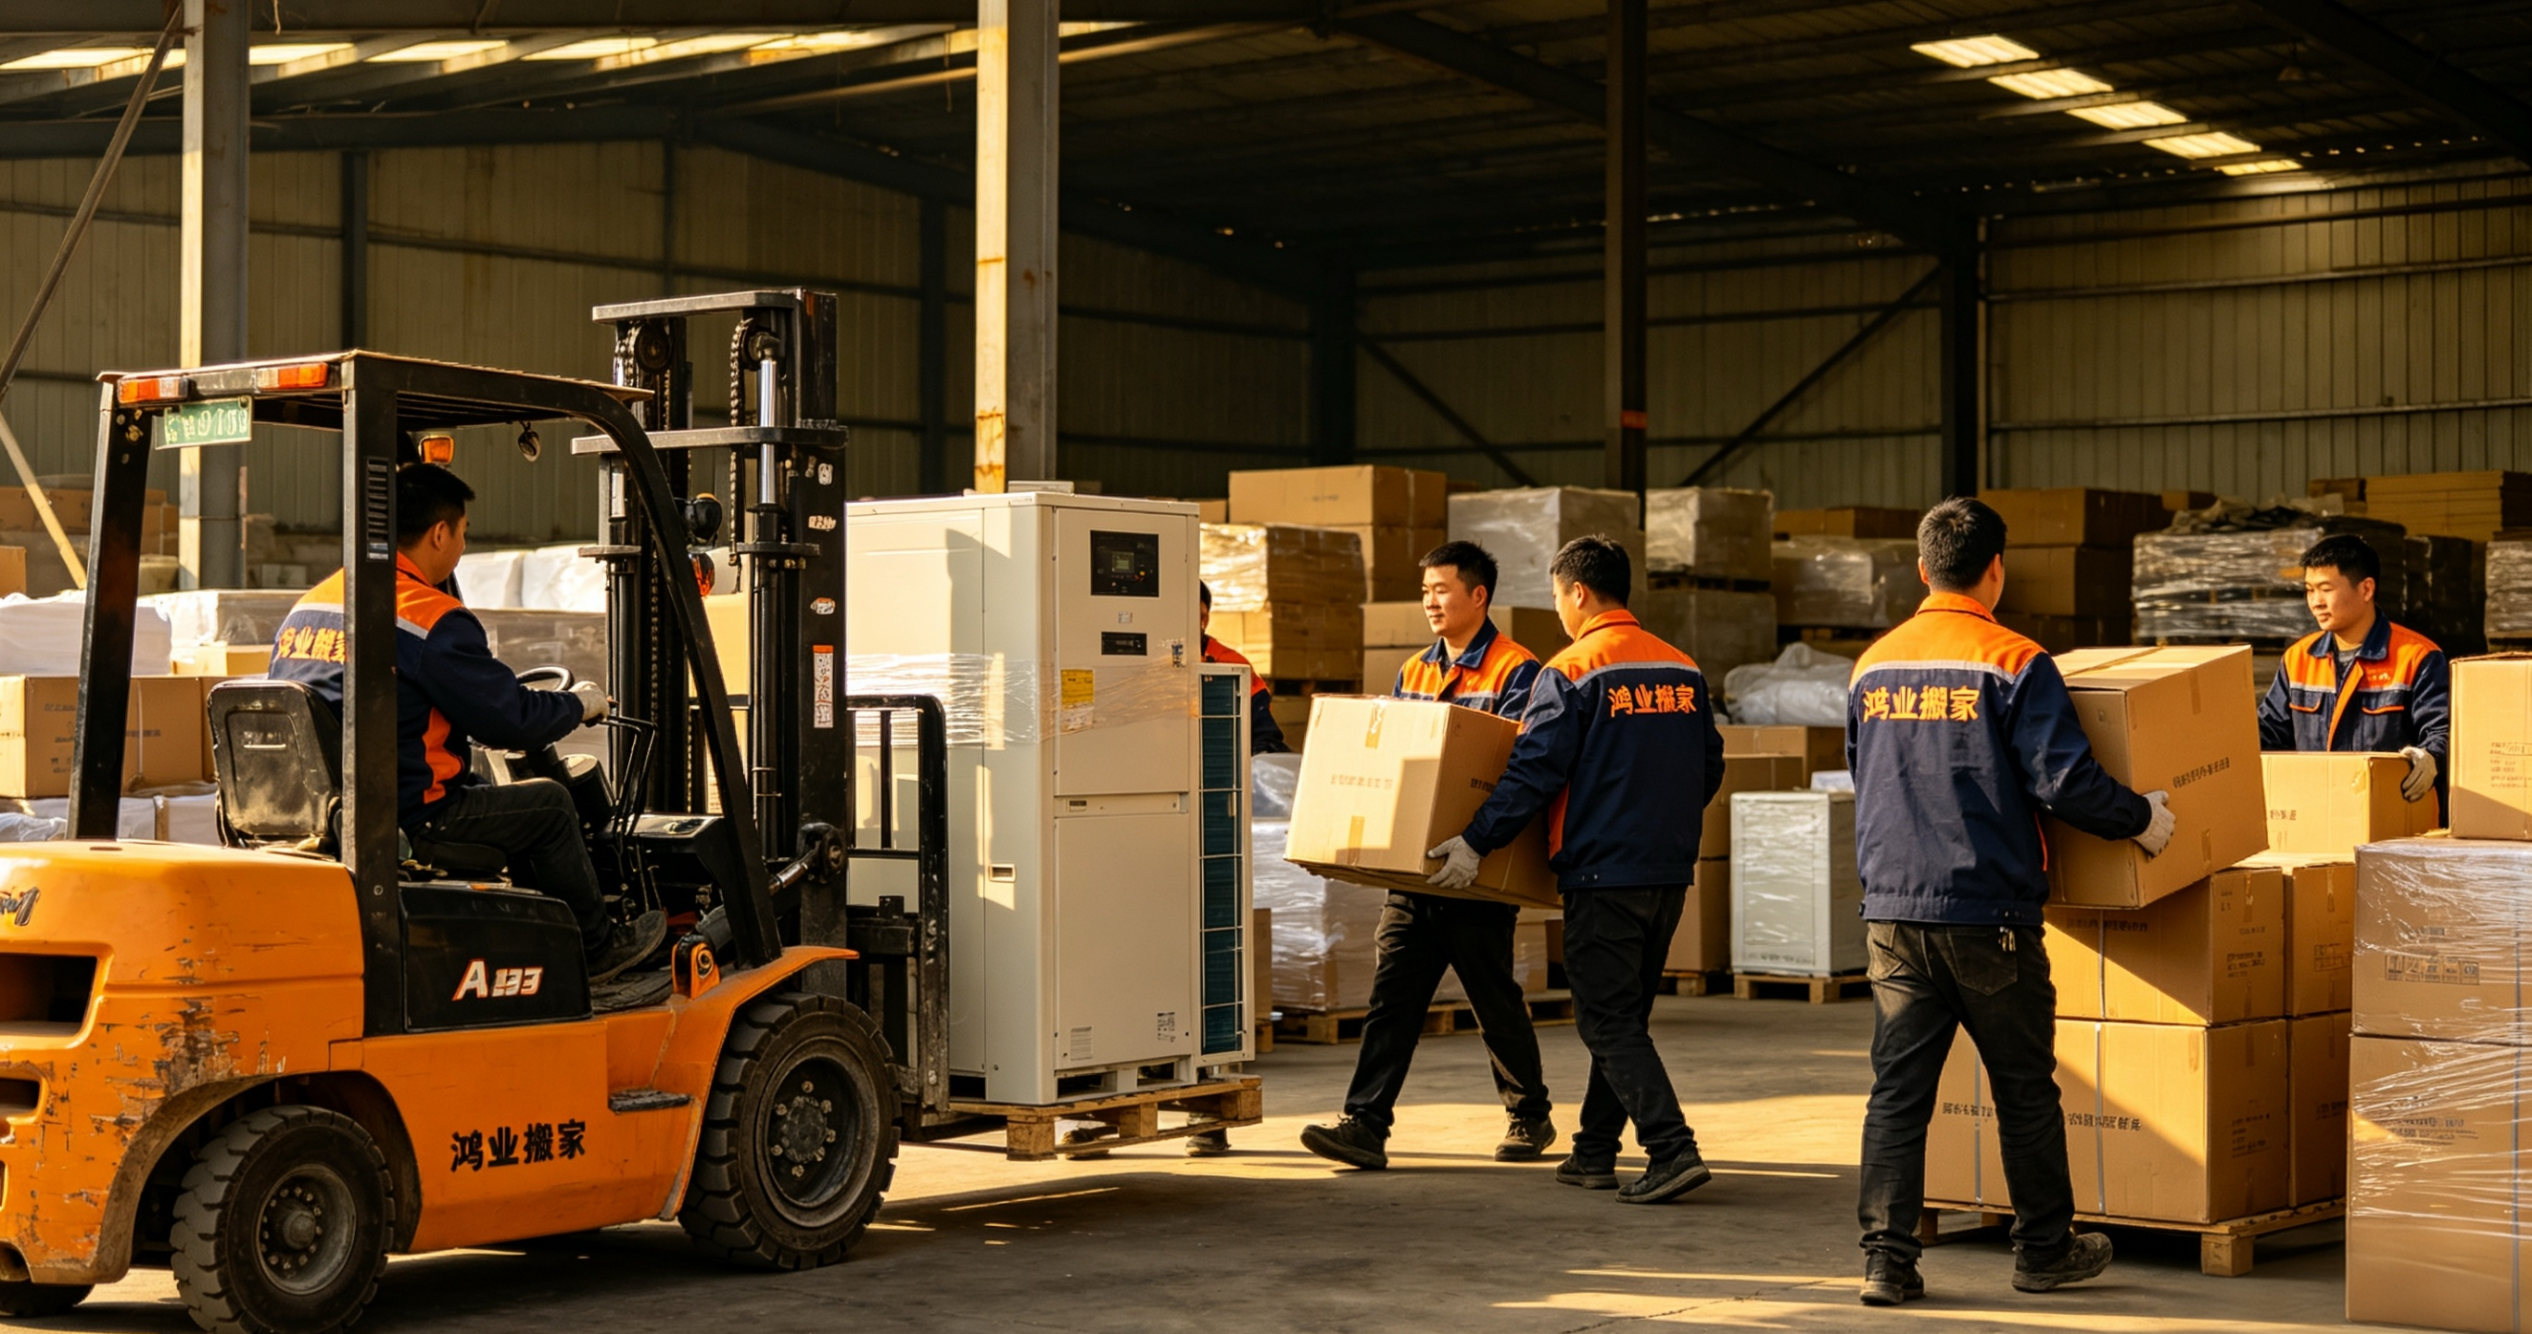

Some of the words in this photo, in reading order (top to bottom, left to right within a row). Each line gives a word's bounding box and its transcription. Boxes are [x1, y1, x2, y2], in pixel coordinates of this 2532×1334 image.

[1608, 683, 1697, 718] 鸿业搬家
[1863, 684, 1980, 723] 鸿业搬家
[450, 1118, 586, 1173] 鸿业搬家
